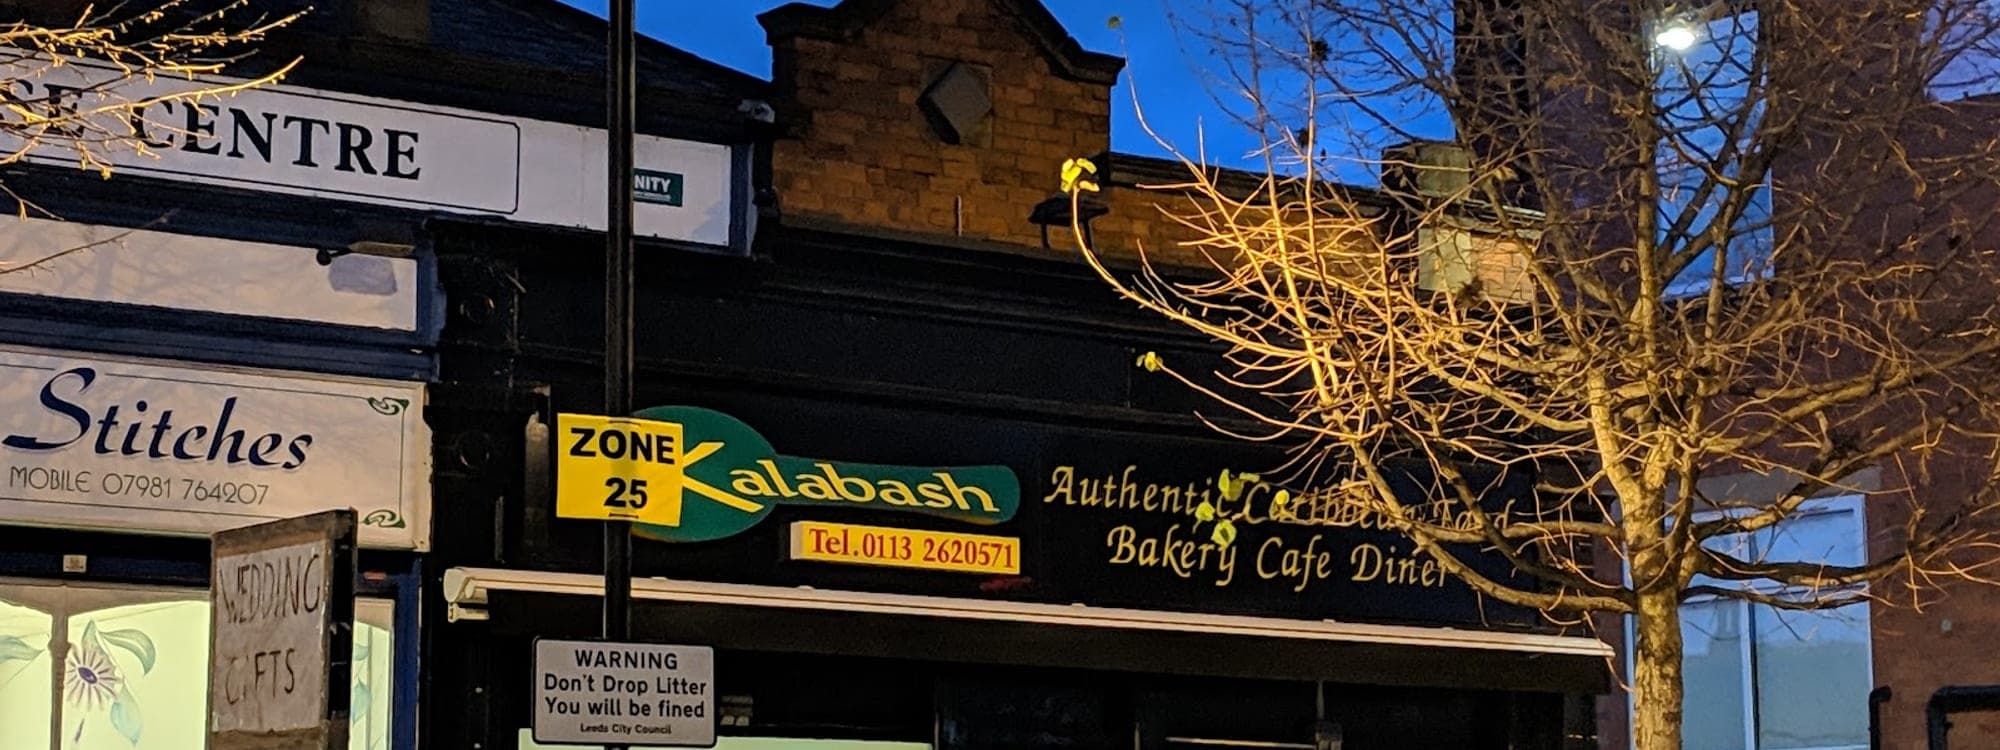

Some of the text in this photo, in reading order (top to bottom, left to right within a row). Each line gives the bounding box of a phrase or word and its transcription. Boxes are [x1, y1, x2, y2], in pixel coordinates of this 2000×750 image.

[130, 96, 422, 181] CENTRE
[2, 367, 313, 470] Stitches
[569, 427, 676, 465] ZONE
[9, 465, 269, 505] MOBILE 07981 764207
[603, 477, 648, 509] 25
[683, 442, 1000, 513] Kalabash
[1043, 464, 1233, 518] Authentic
[1433, 498, 1517, 536] Fod
[922, 537, 1015, 569] 2620571
[1106, 524, 1447, 592] Bakery Cafe Diner
[218, 553, 320, 625] WEDDING
[225, 647, 296, 705] GIFTS
[574, 649, 679, 670] WARNING
[544, 672, 707, 696] Don't Drop Litter
[544, 696, 705, 718] You will be fined
[580, 723, 672, 735] Leeds City Council
